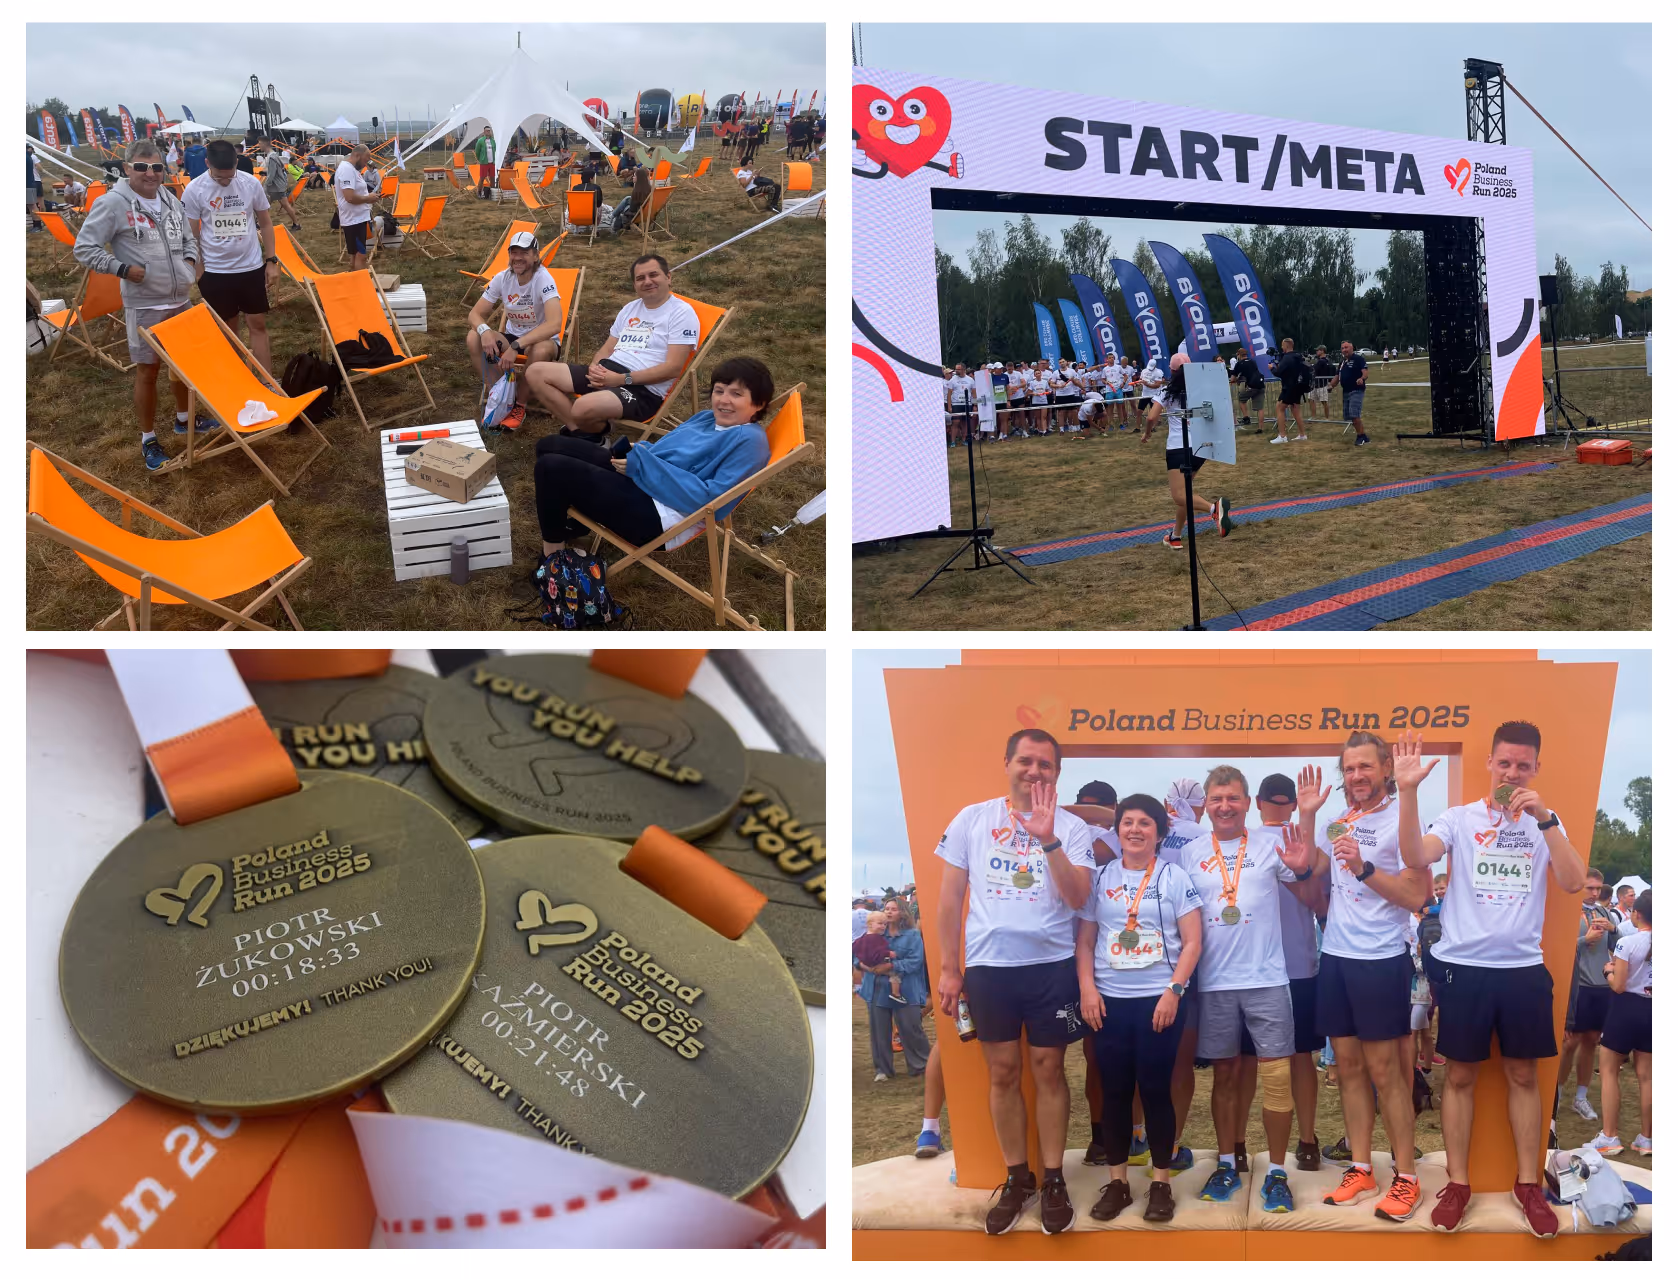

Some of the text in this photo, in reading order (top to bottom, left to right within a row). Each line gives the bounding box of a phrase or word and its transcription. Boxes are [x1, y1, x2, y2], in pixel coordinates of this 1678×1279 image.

[1472, 185, 1517, 198] Run 2025
[1473, 174, 1513, 187] Business
[1474, 162, 1507, 175] Poland
[214, 219, 241, 228] 0144
[542, 285, 555, 294] GLS
[620, 334, 644, 343] 0144
[474, 668, 616, 733] YOU RUN
[1068, 705, 1470, 732] Poland Business Run 2025
[293, 722, 370, 745] RUN
[296, 743, 377, 767] YOU
[531, 709, 703, 784] YOU HELP
[555, 806, 589, 819] RUN
[232, 829, 330, 874] Poland
[233, 844, 354, 892] Business
[738, 816, 814, 875] YOU
[989, 857, 1034, 873] 0144
[1496, 841, 1513, 849] Run
[233, 852, 372, 913] Run 2025
[1477, 861, 1522, 878] 0144
[195, 910, 385, 988] ŻUKOWSKI
[234, 906, 337, 952] PIOTR
[232, 941, 361, 998] 00:18:33
[582, 944, 704, 1033] Business
[600, 931, 704, 1005] Poland
[174, 956, 434, 1059] DZIĘKUJEMY! THANK YOU!
[522, 981, 609, 1052] PIOTR
[562, 957, 705, 1059] Run 2025
[481, 1010, 590, 1098] 00:21:48
[432, 1034, 578, 1151] KUJEMY! THANK
